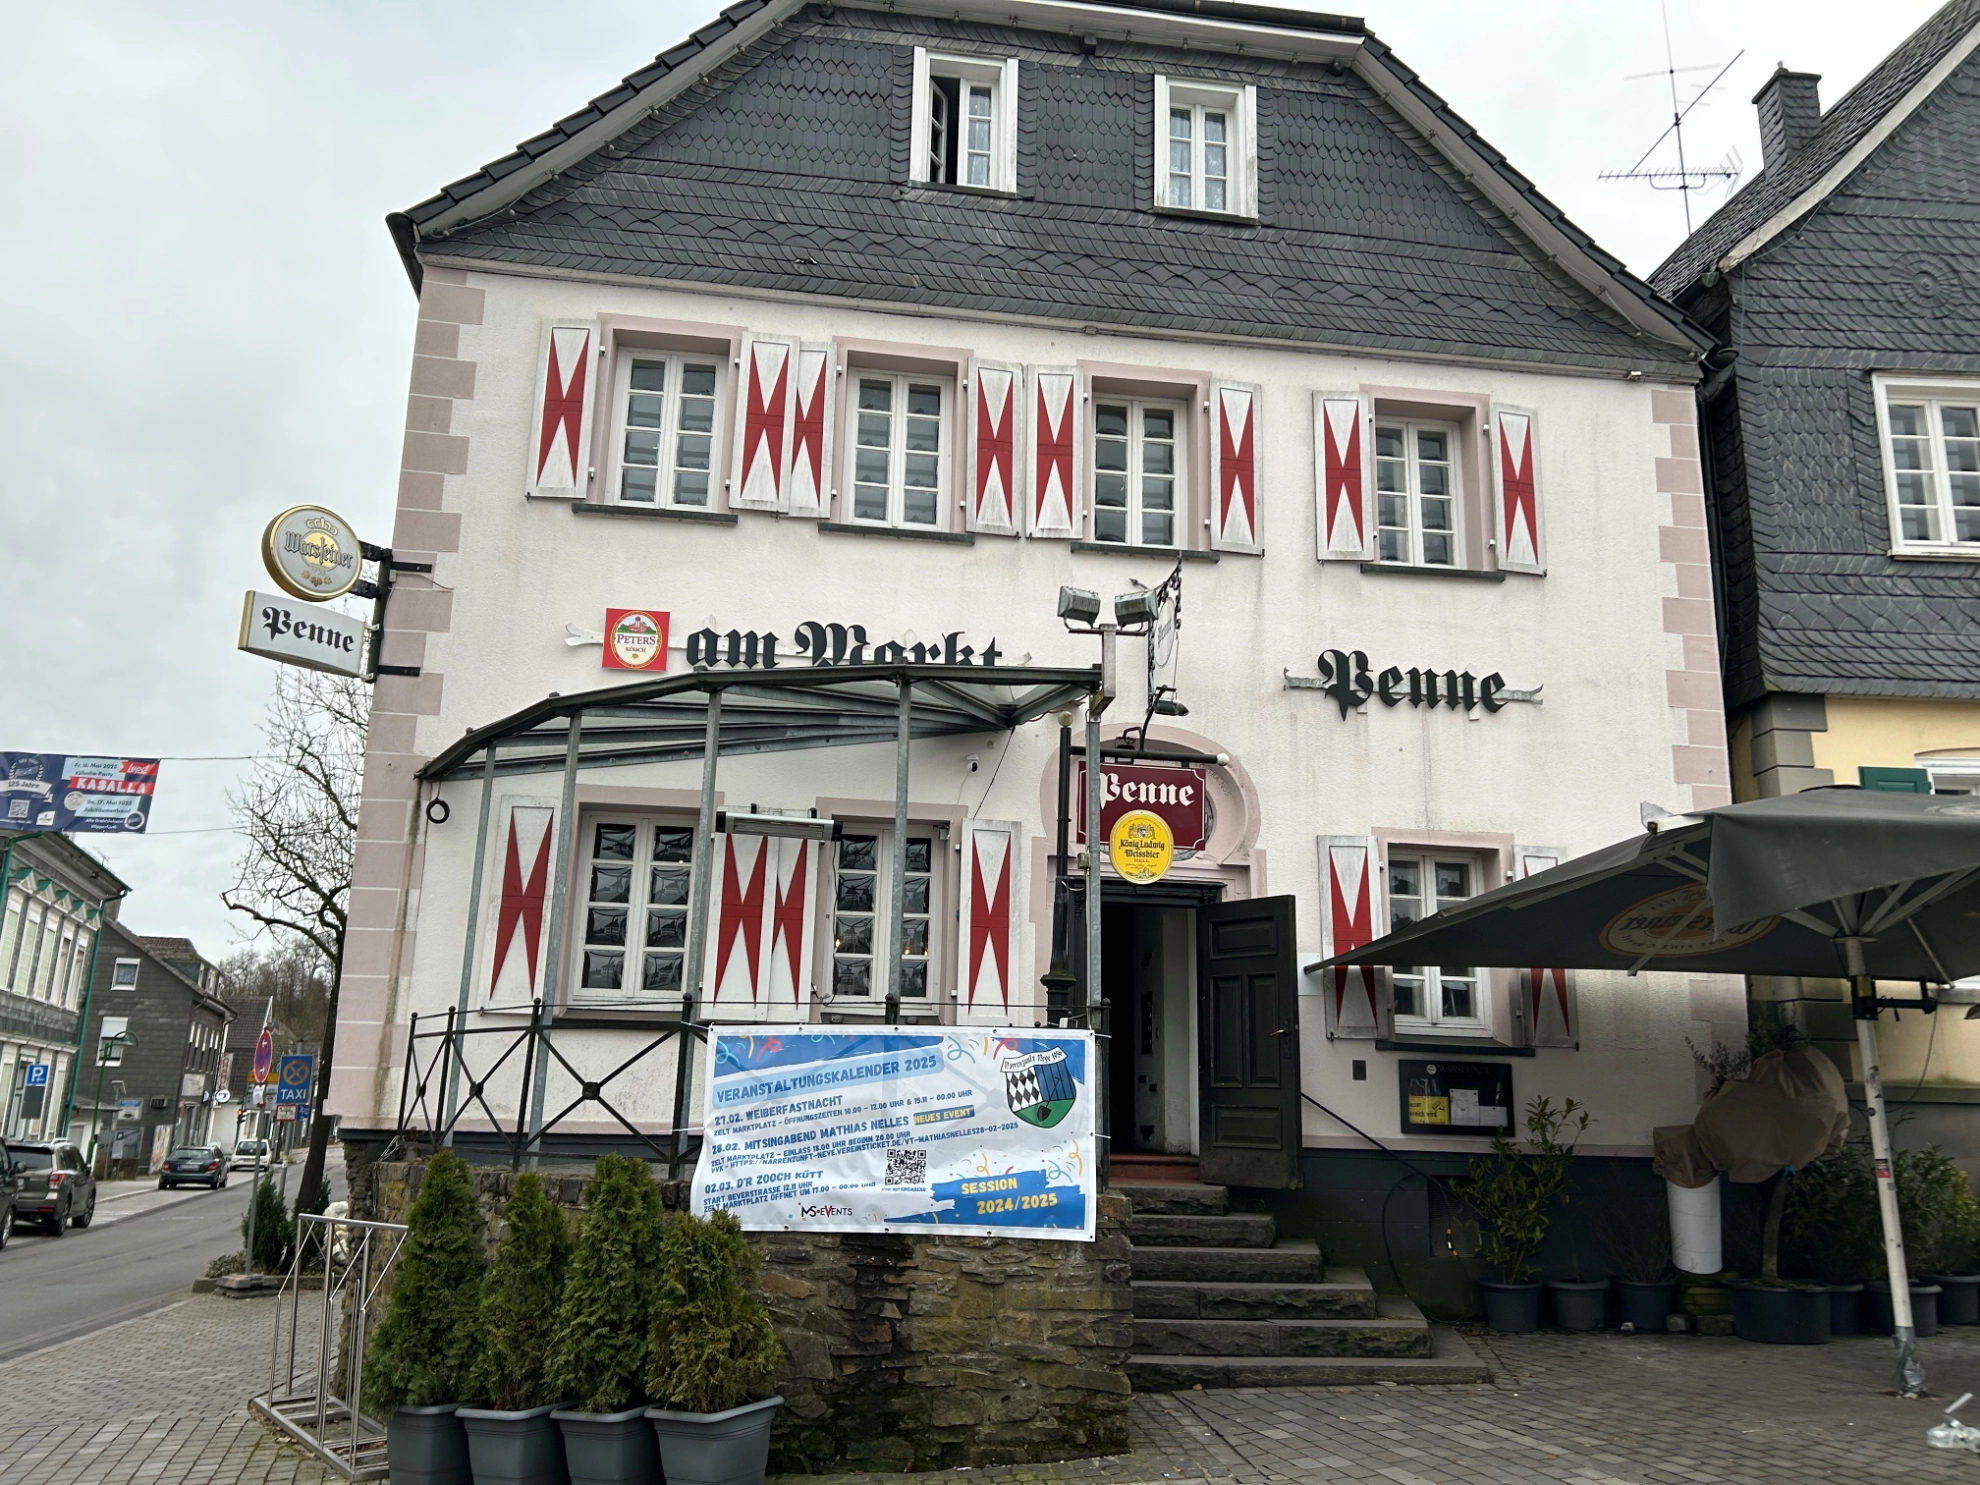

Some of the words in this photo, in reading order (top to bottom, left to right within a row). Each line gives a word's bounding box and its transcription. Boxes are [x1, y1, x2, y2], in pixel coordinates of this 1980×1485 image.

[284, 530, 353, 568] Warsteiner
[310, 565, 327, 576] 1753
[262, 606, 354, 653] Penne
[617, 634, 656, 645] PETERS
[686, 627, 780, 669] am
[795, 621, 1003, 666] Markt
[1317, 649, 1508, 722] Penne
[77, 778, 146, 794] KASALLA
[1100, 772, 1195, 810] Penne
[1119, 839, 1140, 850] König
[1140, 840, 1165, 851] Ludwig
[1124, 849, 1160, 858] Weissbier
[31, 1067, 44, 1083] P
[717, 1062, 900, 1102] VERANSTALTUNGSKALENDER
[905, 1055, 937, 1072] 2025
[281, 1089, 307, 1100] TAXI
[713, 1128, 730, 1136] ZELT
[732, 1120, 777, 1133] MARKTPLATZ
[784, 1109, 843, 1126] ÖFFNUNGSZEITEN
[844, 1106, 862, 1115] 10.00
[870, 1102, 887, 1111] 12.00
[889, 1099, 904, 1108] UHR
[936, 1091, 956, 1101] 00.00
[958, 1089, 973, 1098] UHR
[715, 1113, 743, 1126] 27.02.
[745, 1095, 843, 1121] WEIBERFASTNACHT
[711, 1142, 741, 1155] 28.02.
[744, 1131, 817, 1151] MITSINGABEND
[820, 1122, 867, 1139] MATHIAS
[870, 1116, 909, 1130] NELLES
[711, 1157, 725, 1167] ZELT
[727, 1151, 775, 1162] MARKTPLATZ
[783, 1146, 811, 1157] EINLASS
[813, 1144, 830, 1153] 18.00
[832, 1140, 846, 1149] UHR
[849, 1136, 873, 1146] BEGINN
[875, 1133, 895, 1142] 20.00
[898, 1130, 911, 1139] UHR
[703, 1195, 726, 1206] START
[728, 1185, 780, 1201] BEVERSTRASSE
[798, 1181, 813, 1189] UHR
[705, 1182, 734, 1194] 02.03.
[737, 1176, 752, 1189] D'R
[756, 1171, 791, 1185] ZOOCH
[795, 1170, 823, 1179] KÜTT
[961, 1178, 1018, 1195] SESSION
[703, 1204, 721, 1213] ZELT
[723, 1196, 768, 1209] MARKTPLATZ
[770, 1190, 797, 1200] ÖFFNET
[799, 1187, 810, 1196] UM
[812, 1185, 830, 1194] 17.00
[977, 1193, 1058, 1215] 2024/2025
